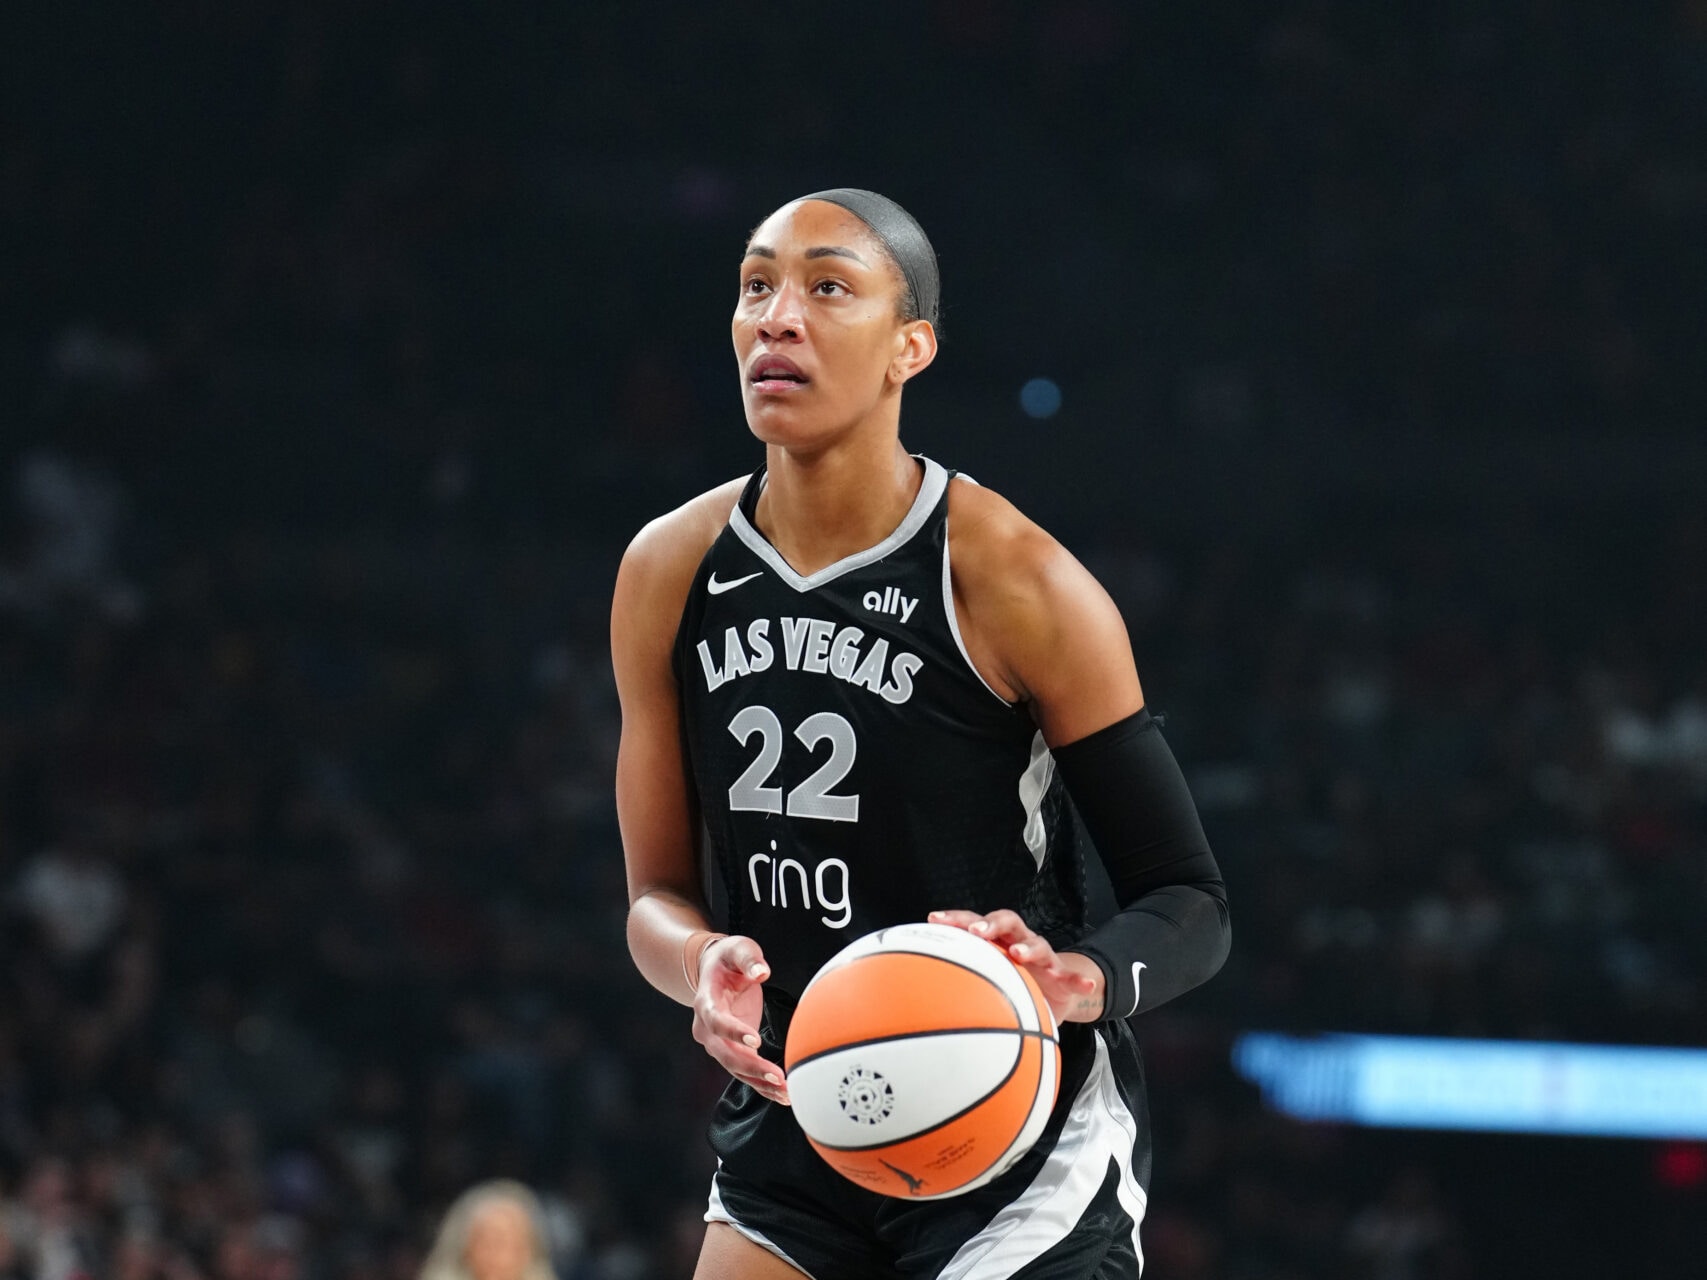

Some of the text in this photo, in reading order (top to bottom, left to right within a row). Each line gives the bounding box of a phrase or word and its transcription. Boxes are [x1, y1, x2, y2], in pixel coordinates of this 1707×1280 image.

[862, 586, 919, 623] ally
[696, 616, 924, 704] LAS VEGAS
[727, 705, 860, 823] 22
[748, 839, 852, 929] ring
